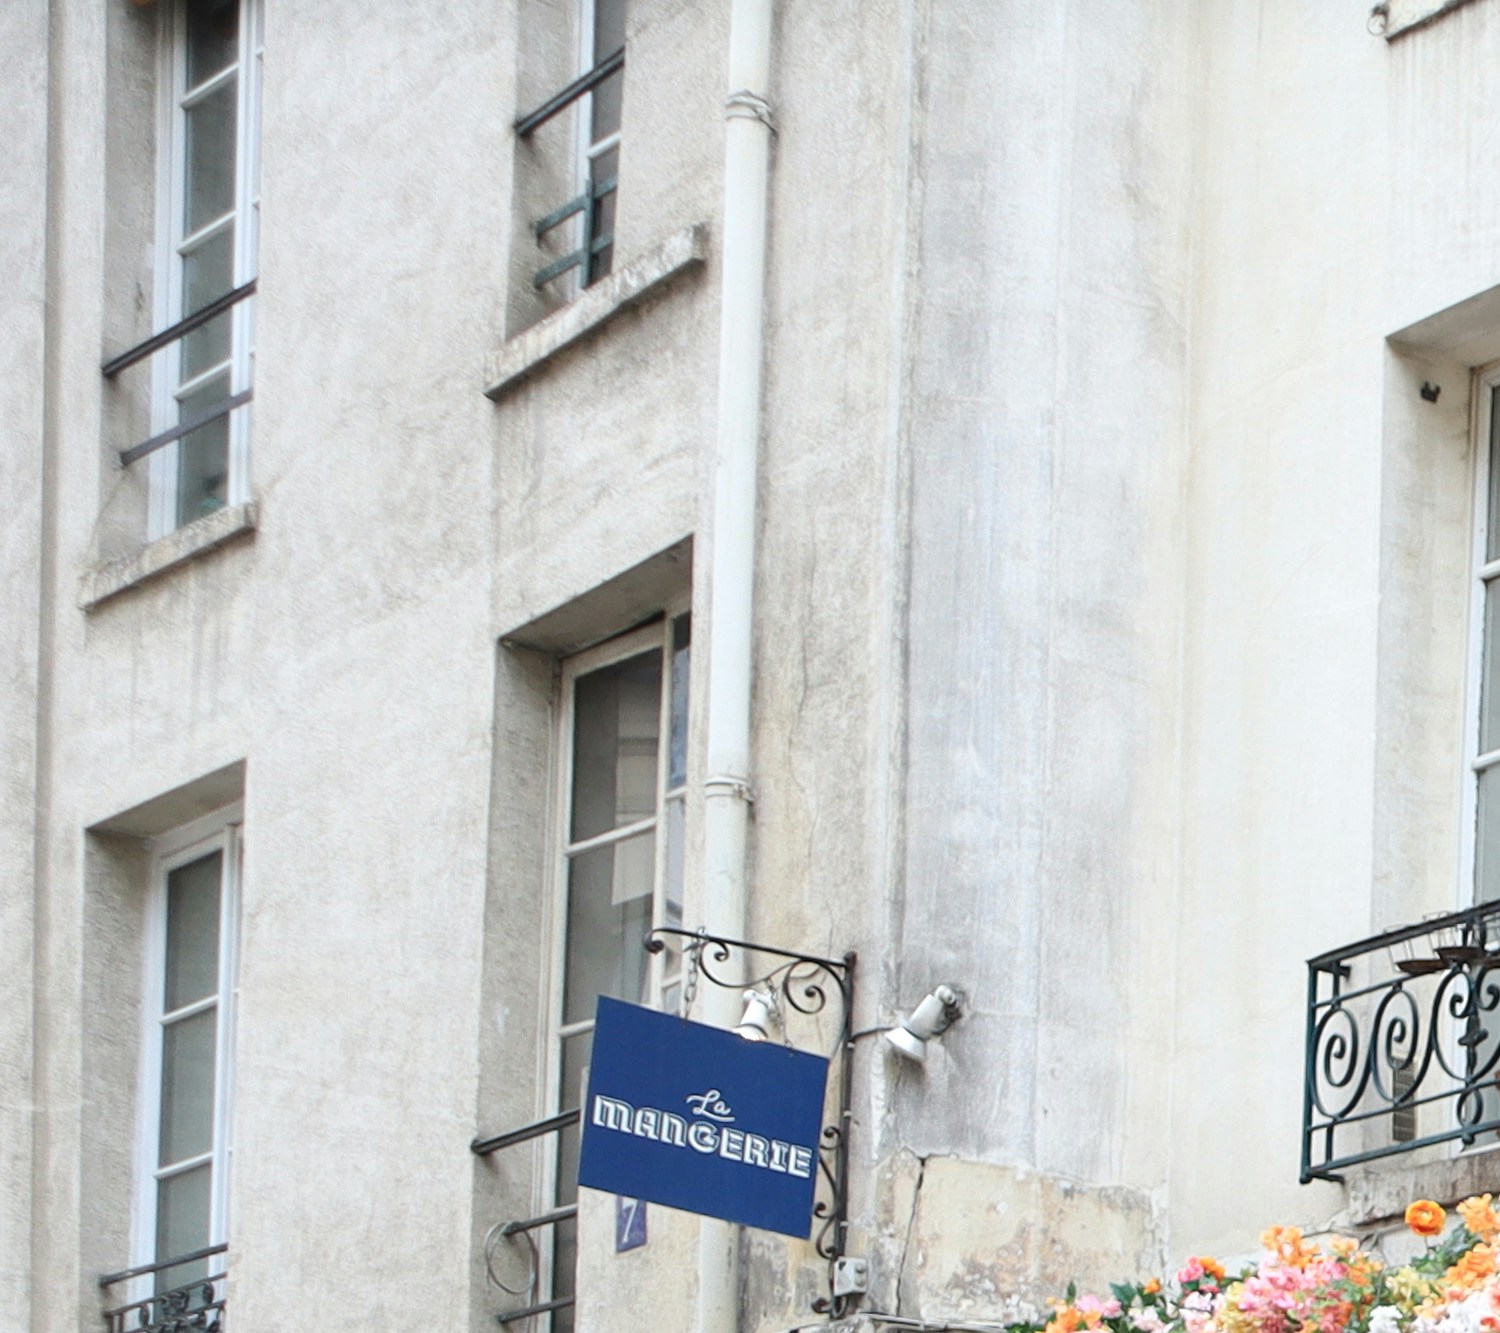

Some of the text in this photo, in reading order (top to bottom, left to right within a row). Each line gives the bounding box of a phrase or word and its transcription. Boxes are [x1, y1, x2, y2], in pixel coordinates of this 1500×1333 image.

[686, 1089, 736, 1123] La
[592, 1094, 813, 1179] MANGERIE
[621, 1200, 639, 1244] 7
